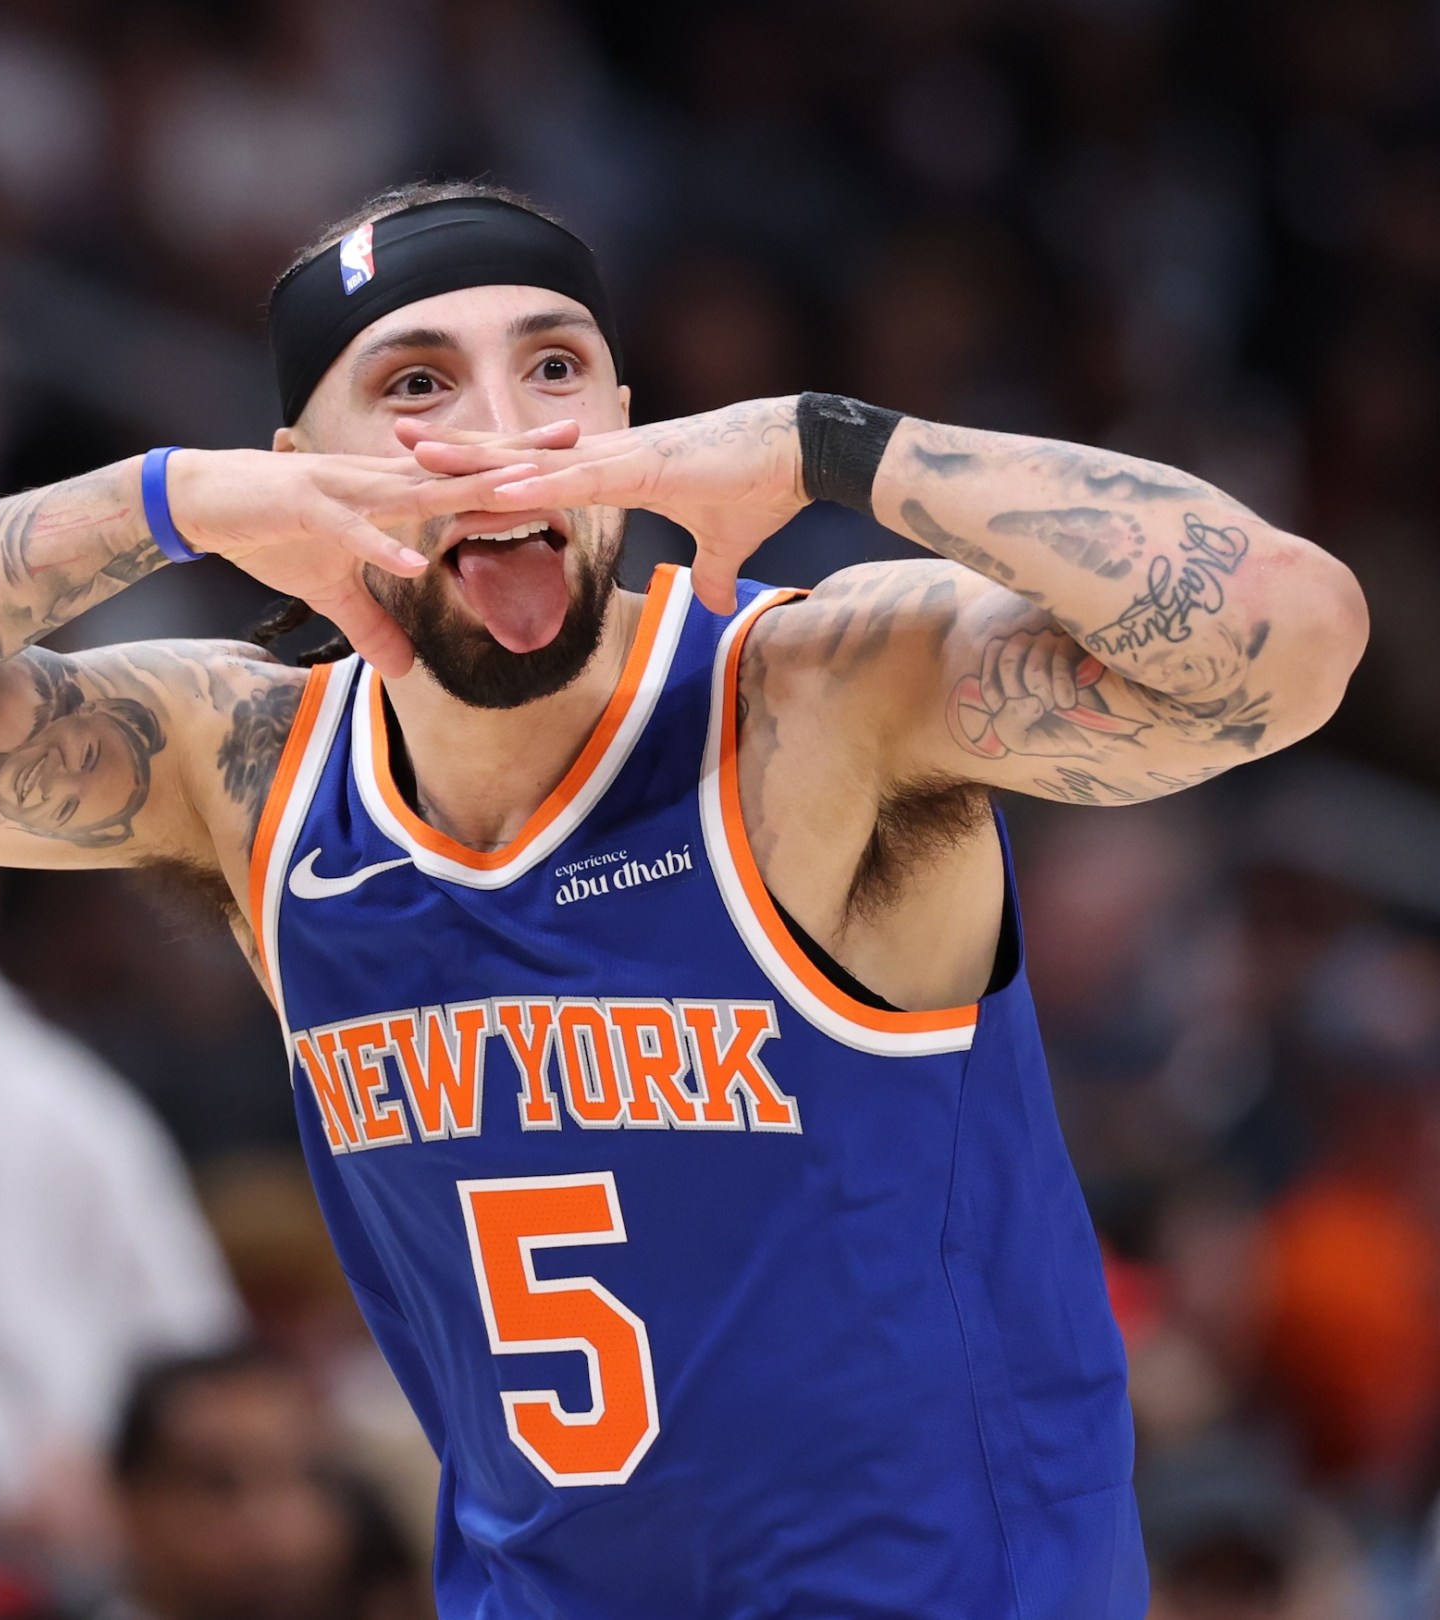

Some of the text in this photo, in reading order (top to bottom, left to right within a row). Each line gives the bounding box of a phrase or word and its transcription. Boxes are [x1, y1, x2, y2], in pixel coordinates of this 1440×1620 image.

[346, 271, 363, 292] NBA
[555, 849, 628, 877] experience
[555, 876, 610, 905] abu
[291, 995, 803, 1156] NEW YORK
[456, 1170, 660, 1488] 5
